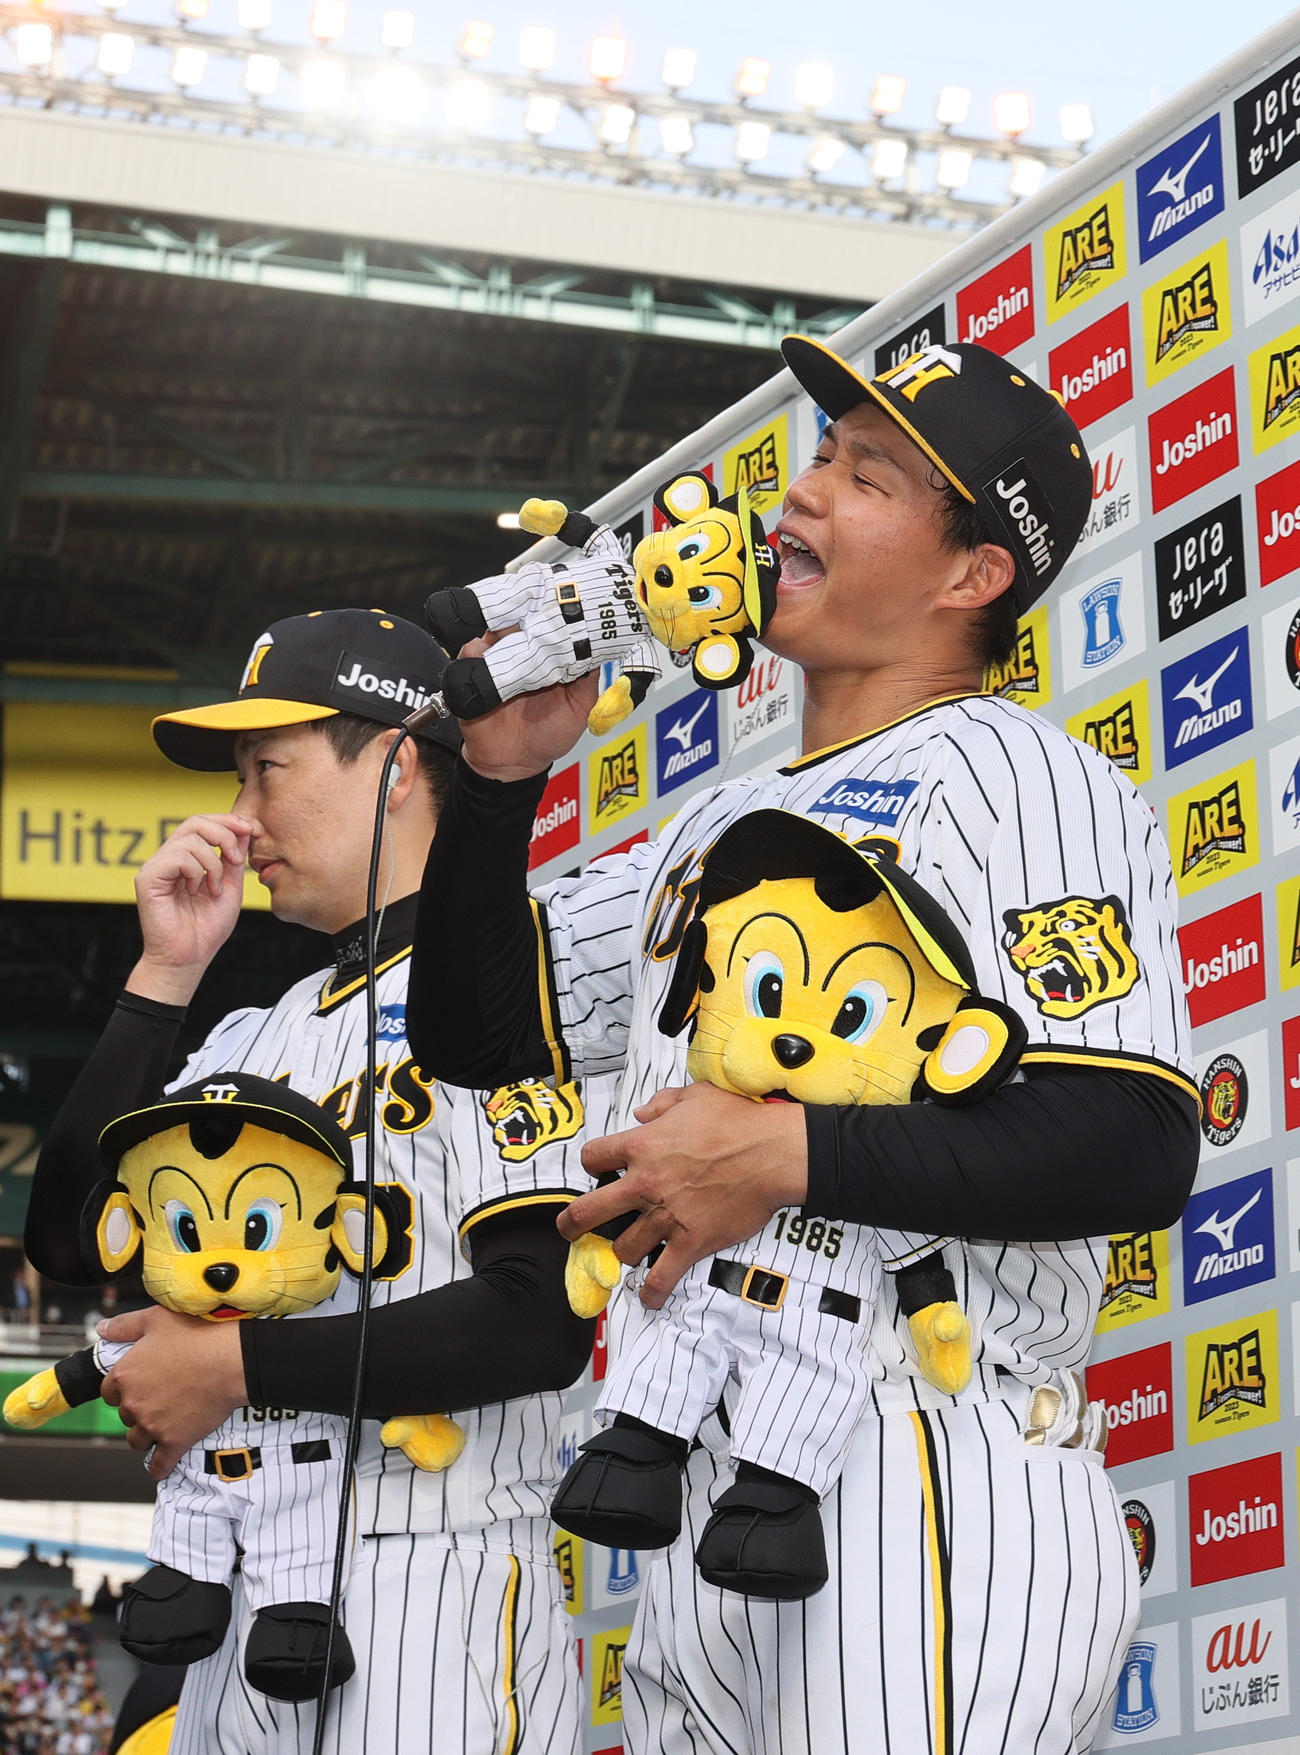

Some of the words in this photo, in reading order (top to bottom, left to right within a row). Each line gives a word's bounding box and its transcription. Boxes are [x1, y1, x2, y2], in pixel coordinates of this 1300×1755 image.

[1249, 118, 1300, 175] セ・リー
[962, 286, 1029, 343] Joshin
[1062, 346, 1127, 403] Joshin
[1156, 411, 1232, 475] Joshin
[996, 478, 1055, 576] Joshin
[598, 601, 618, 640] 1985
[605, 563, 643, 633] Tigers
[818, 784, 905, 816] Joshin
[1183, 938, 1258, 994] Joshin
[1202, 1057, 1243, 1091] HANSHIN
[1206, 1117, 1242, 1145] Tigers
[774, 1211, 844, 1260] 1985
[1122, 1504, 1150, 1526] NSHIN
[1195, 1496, 1278, 1546] Joshin
[1206, 1618, 1273, 1673] au
[1201, 1674, 1280, 1714] じぶん銀行
